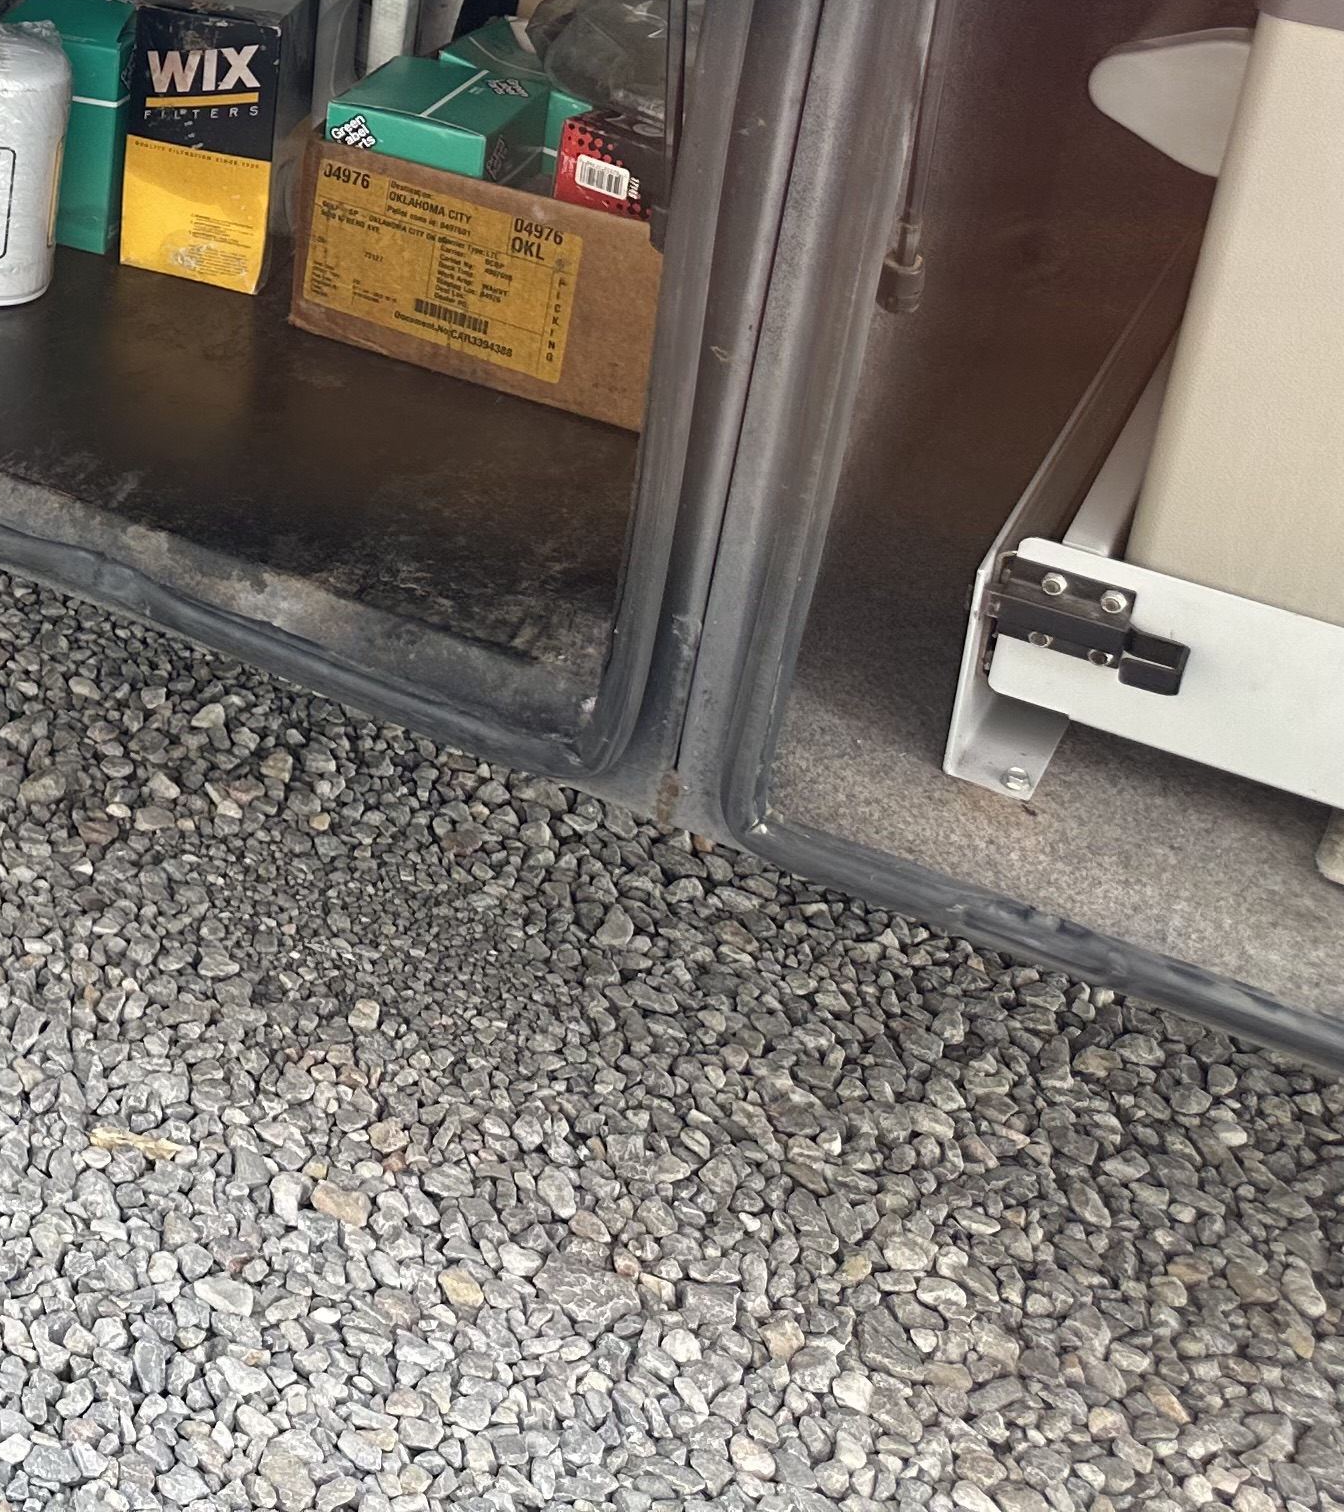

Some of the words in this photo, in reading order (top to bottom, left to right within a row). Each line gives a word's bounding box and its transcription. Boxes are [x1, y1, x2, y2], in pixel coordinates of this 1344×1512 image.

[147, 44, 261, 93] WIX
[144, 105, 259, 120] FILTERS
[331, 115, 366, 139] Green
[343, 124, 370, 145] abel
[389, 191, 445, 217] OKLAHOMA
[448, 209, 472, 224] CITY
[513, 218, 564, 245] 04976
[511, 236, 545, 262] OKL
